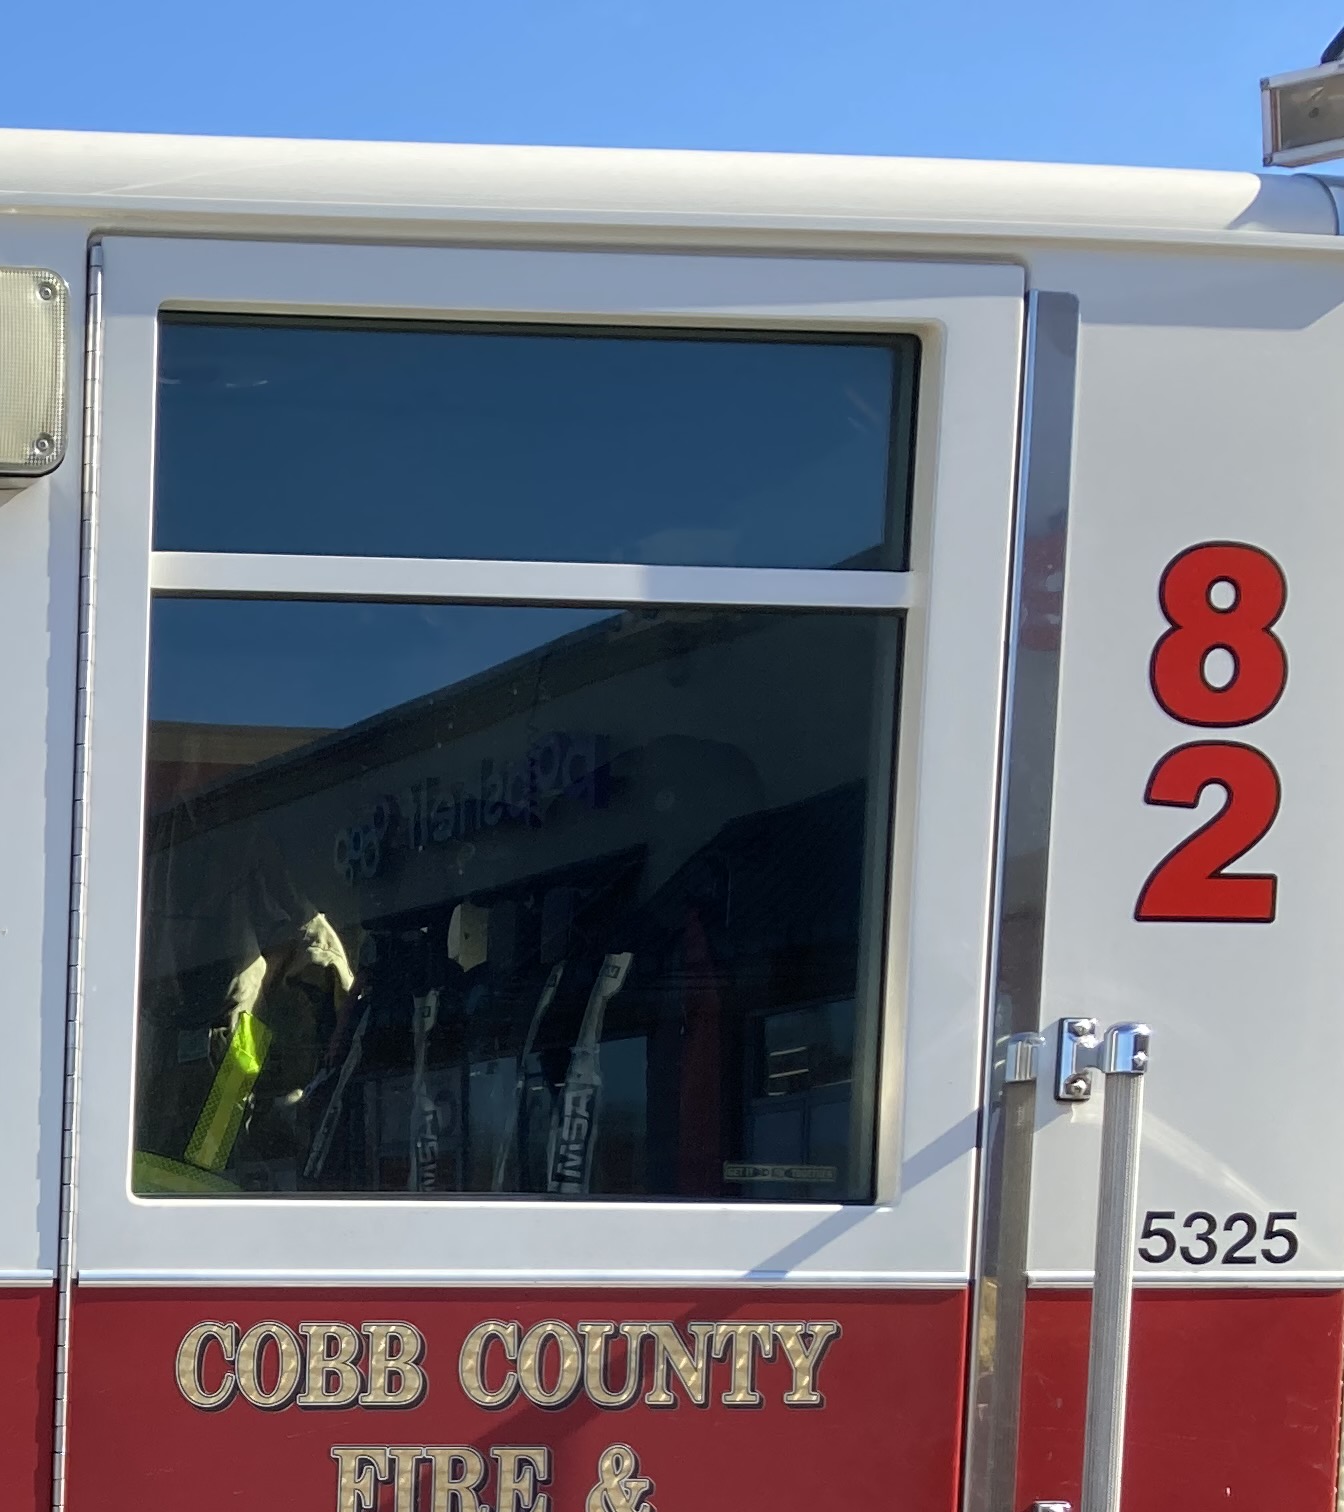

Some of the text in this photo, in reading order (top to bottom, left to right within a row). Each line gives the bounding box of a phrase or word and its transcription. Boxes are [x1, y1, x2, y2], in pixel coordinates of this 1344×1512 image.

[1134, 540, 1288, 923] 82
[556, 1088, 593, 1180] MSA
[1137, 1210, 1299, 1266] 5325
[175, 1318, 843, 1411] COBB COUNTY
